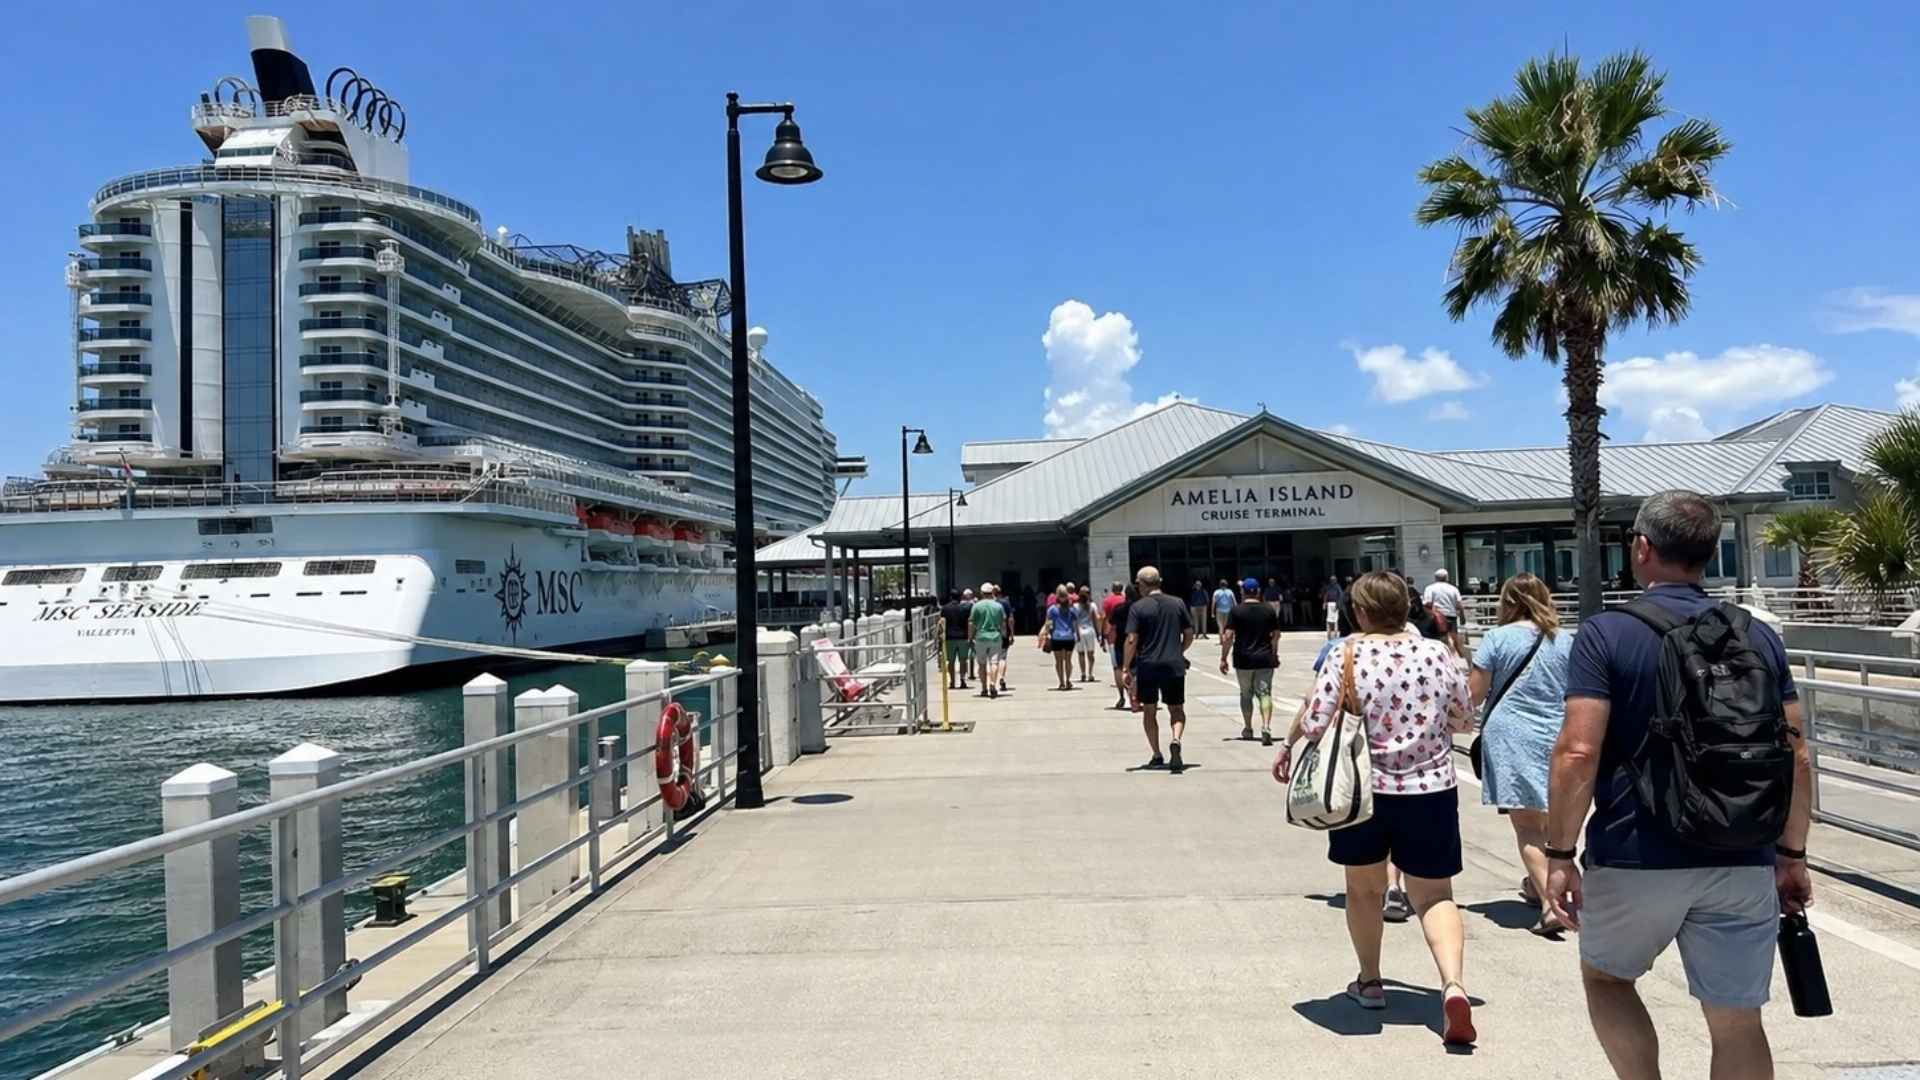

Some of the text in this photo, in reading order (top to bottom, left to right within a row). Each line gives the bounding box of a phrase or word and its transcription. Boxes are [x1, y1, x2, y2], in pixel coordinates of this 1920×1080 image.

[1170, 484, 1354, 506] AMELIA ISLAND
[1201, 507, 1326, 521] CRUISE TERMINAL
[535, 570, 584, 615] MSC
[32, 601, 207, 622] MSC SEASIDE
[77, 628, 136, 637] VALLETTA
